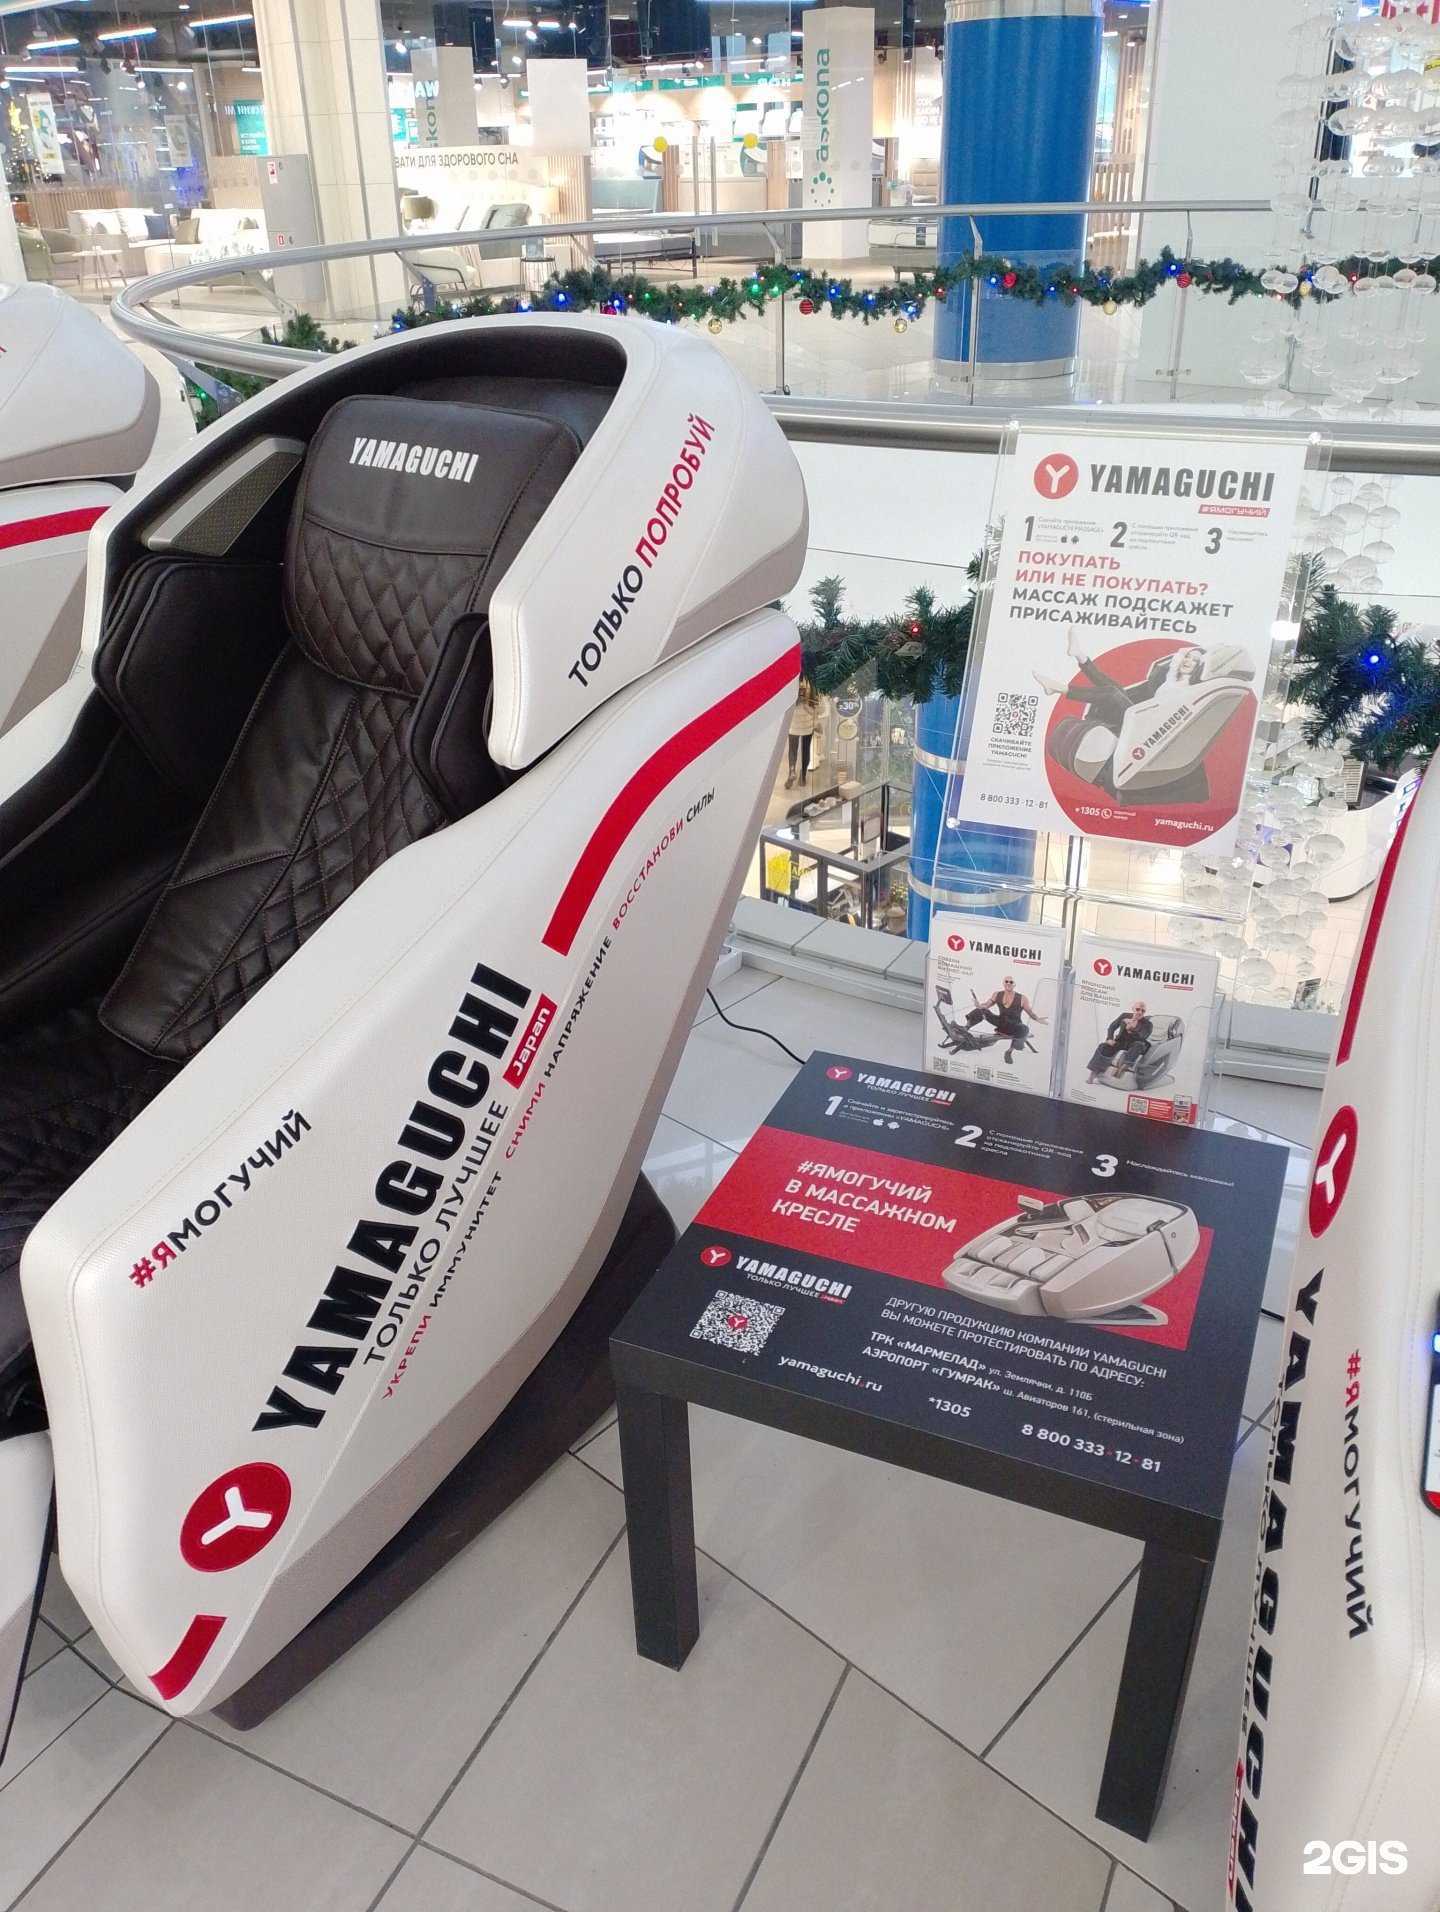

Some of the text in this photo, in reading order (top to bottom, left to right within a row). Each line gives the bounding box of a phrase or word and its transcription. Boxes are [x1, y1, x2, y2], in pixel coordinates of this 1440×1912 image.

[816, 48, 831, 162] askona
[418, 155, 437, 168] ДЛЯ
[439, 152, 496, 168] ЗДОРОВОГО
[498, 152, 518, 166] СНА
[349, 436, 479, 483] YAMAGUCHI
[1090, 464, 1275, 501] YAMAGUCHI
[1024, 516, 1034, 542] 1
[1110, 522, 1128, 548] 2
[1205, 528, 1222, 554] 3
[567, 414, 718, 691] ТОЛЬКО ПОПРОБУЙ
[1018, 550, 1120, 570] ПОКУПАТЬ
[1015, 569, 1208, 596] ИЛИ НЕ ПОКУПАТЬ?
[1009, 606, 1197, 634] ПРИСАЖИВАЙТЕСЬ
[1012, 588, 1233, 618] МАССАЖ ПОДСКАЖЕТ
[1143, 704, 1189, 748] YAMAGUCHI
[980, 793, 986, 801] 8
[988, 794, 1003, 803] 800
[1005, 796, 1020, 806] 333
[1039, 801, 1048, 809] 81
[1155, 818, 1214, 832] yamaguchi.ru
[970, 940, 1042, 960] YAMAGUCHI
[1117, 965, 1195, 985] YAMAGUCHI
[511, 1007, 552, 1077] Japan
[382, 787, 716, 1400] УКРЕПИ ИММУНИТЕТ СНИМИ НАПРЯЖЕНИЕ ВОССТАНОВИ СИЛЫ
[857, 1072, 956, 1102] YAMAGUCHI
[825, 1096, 843, 1116] 1
[954, 1125, 983, 1148] 2
[797, 1160, 933, 1204] #ЯМОГУЧИЙ
[1091, 1154, 1118, 1177] 3
[128, 1107, 312, 1288] #ЯМОГУЧИЙ
[251, 962, 532, 1432] YAMAGUCHI
[771, 1199, 860, 1232] КРЕСЛЕ
[784, 1179, 958, 1233] В МАССАЖНОМ
[362, 1100, 510, 1365] ТОЛЬКО ЛУЧШЕЕ
[736, 1256, 852, 1299] YAMAGUCHI
[747, 1273, 780, 1288] ТОЛЬКО
[782, 1282, 820, 1300] ЛУЧШЕЕ
[870, 1332, 894, 1346] ТРК
[897, 1340, 986, 1372] «МАРМЕЛАД»
[881, 1309, 1145, 1388] ВЫ МОЖЕТЕ ПРОТЕСТИРОВАТЬ ПО АДРЕСУ:
[886, 1296, 1167, 1378] ДРУГУЮ ПРОДУКЦИЮ КОМПАНИИ YAMAGUCHI
[778, 1354, 882, 1392] yamaguchi.ru
[862, 1346, 930, 1372] АЭРОПОРТ
[932, 1366, 1001, 1392] «ГУМРАК»
[1003, 1387, 1015, 1396] ш.
[1017, 1390, 1069, 1412] Авиаторов
[1093, 1412, 1154, 1436] (стерильная
[1156, 1428, 1185, 1446] зона)
[1021, 1424, 1162, 1474] 8 800 333 12 81
[1343, 1350, 1375, 1640] #ЯМОГУЧИЙ
